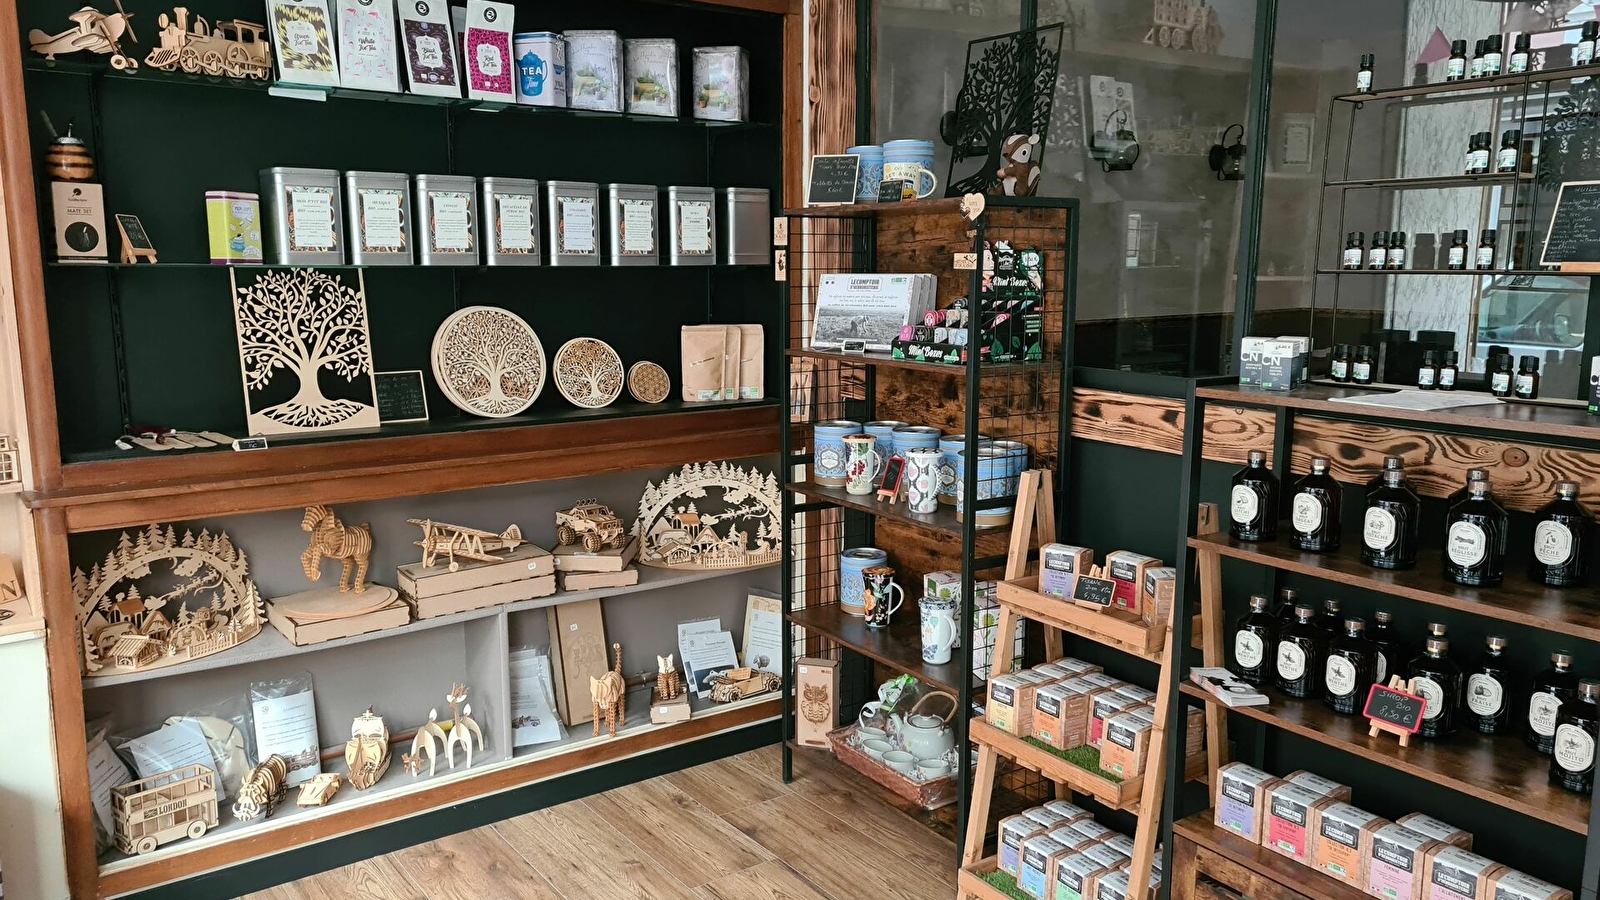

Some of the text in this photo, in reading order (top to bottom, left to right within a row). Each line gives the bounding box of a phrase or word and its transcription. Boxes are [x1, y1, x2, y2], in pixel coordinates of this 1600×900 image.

[521, 67, 542, 76] TEA
[908, 344, 943, 358] Mint Boxes
[1241, 352, 1259, 361] CN
[1262, 355, 1281, 366] CN
[1080, 577, 1102, 586] TISANE
[1379, 690, 1409, 701] SIROP
[1379, 705, 1413, 724] 8,50 €
[1559, 750, 1585, 763] MOJITO
[159, 799, 188, 815] LONDON
[1382, 849, 1409, 863] COMPTOIR
[1443, 874, 1471, 889] COMPTOIR
